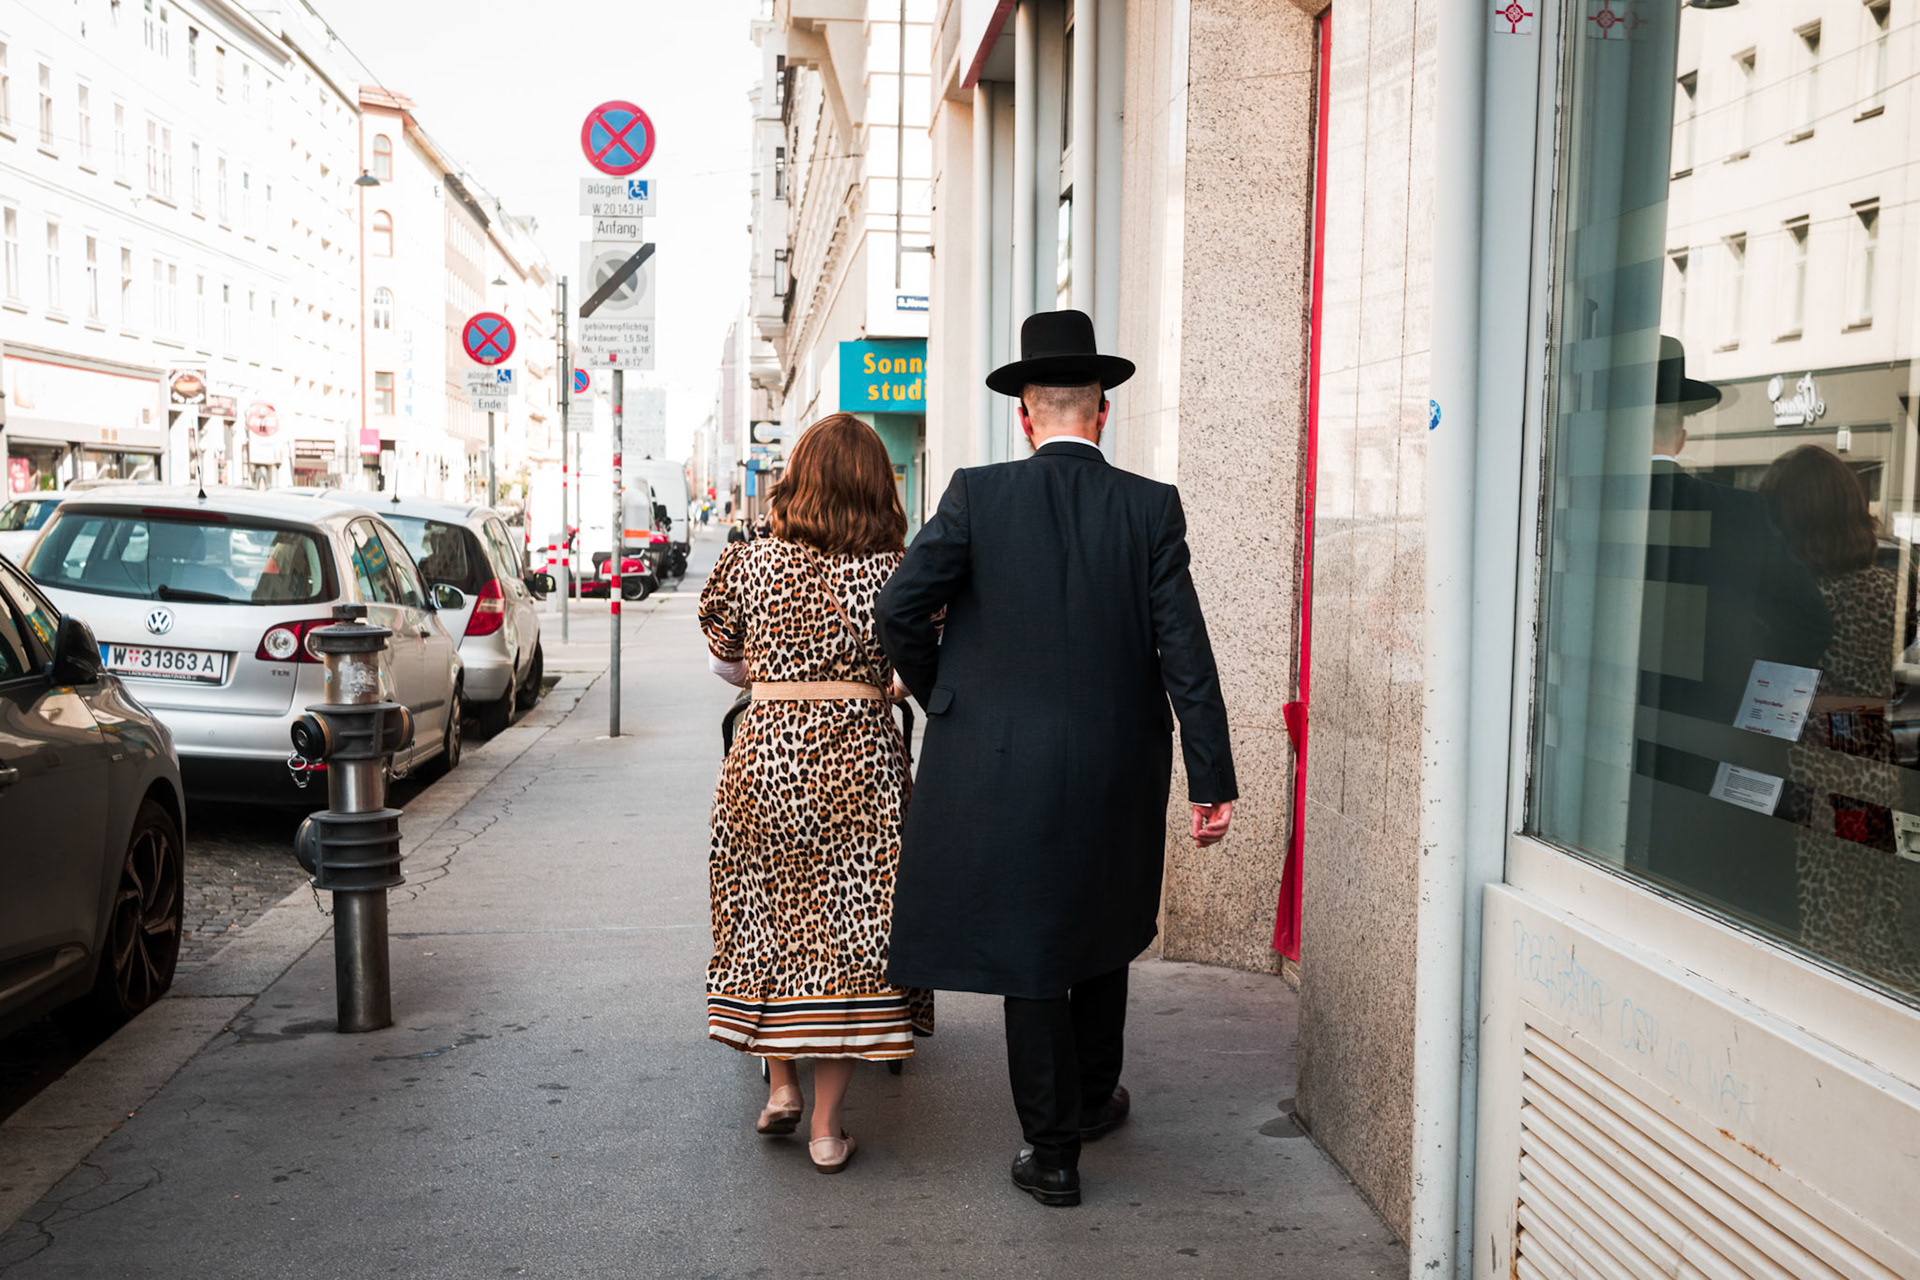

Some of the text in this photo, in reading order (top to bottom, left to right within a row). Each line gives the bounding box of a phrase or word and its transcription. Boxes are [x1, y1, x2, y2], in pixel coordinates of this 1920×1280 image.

[597, 220, 636, 238] Anfang
[584, 322, 649, 332] gebührenpflichtig
[863, 352, 928, 374] Sonn
[478, 398, 502, 409] Ende
[113, 647, 214, 672] W 31363 A
